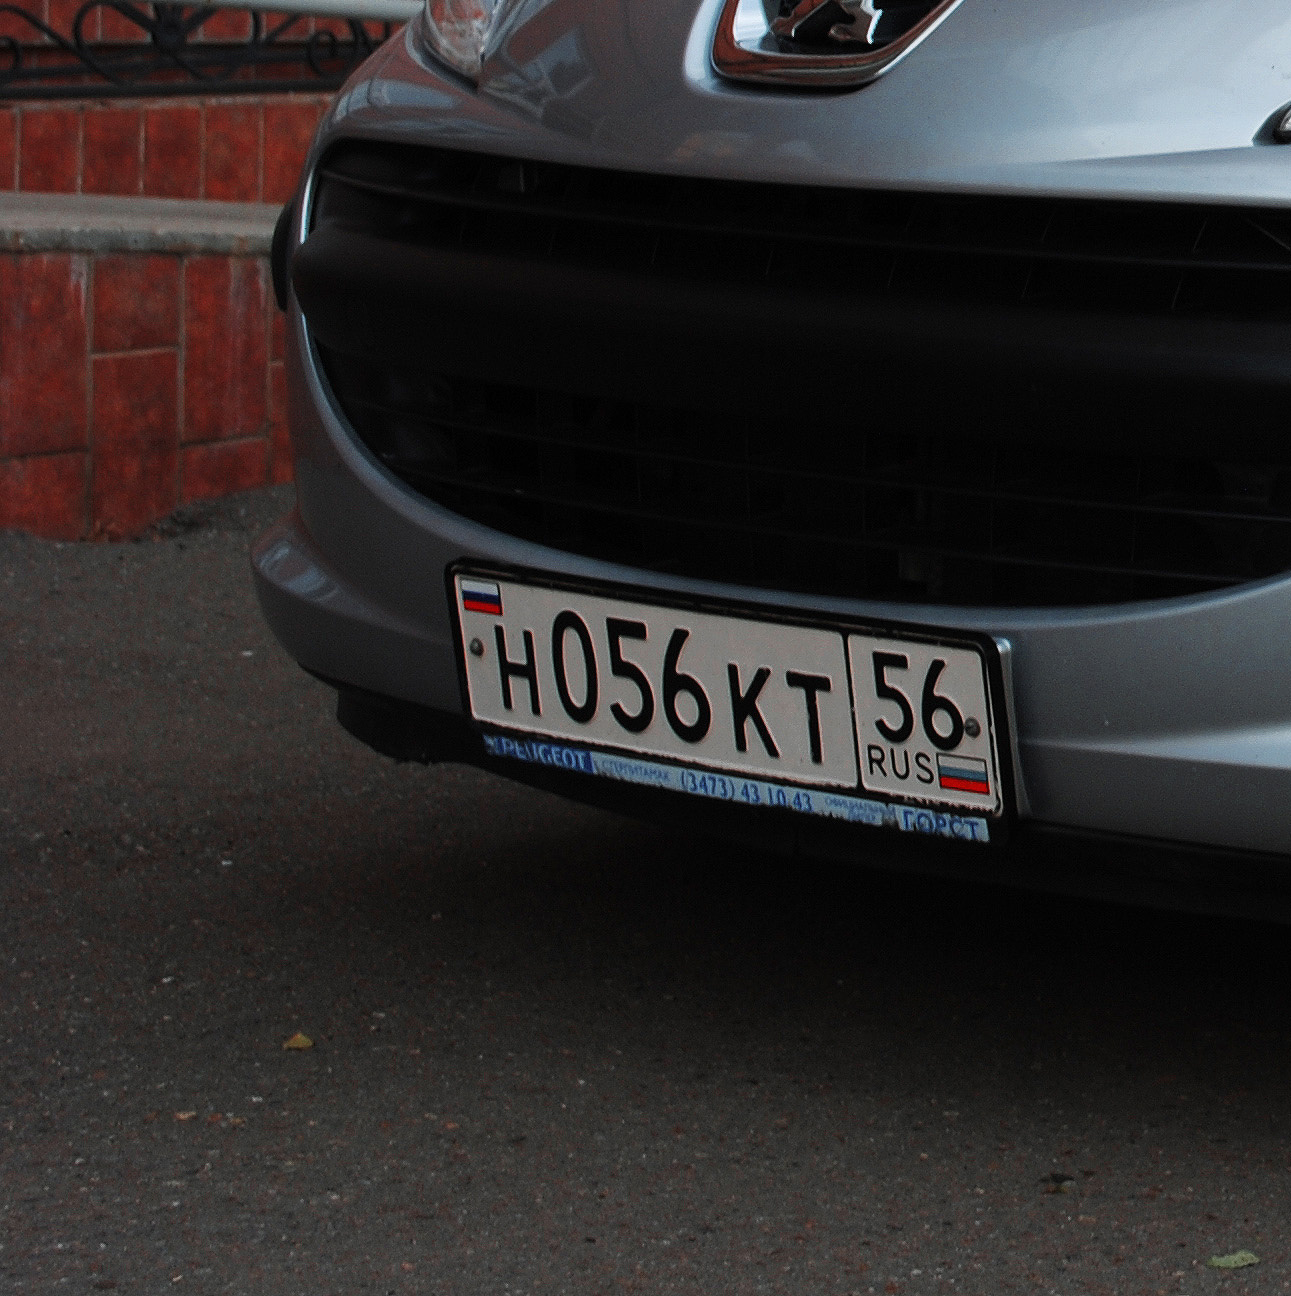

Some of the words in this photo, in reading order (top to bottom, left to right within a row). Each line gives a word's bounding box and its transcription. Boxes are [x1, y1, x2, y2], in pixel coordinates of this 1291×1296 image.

[871, 651, 965, 751] 56
[866, 744, 935, 785] RUS
[681, 769, 735, 799] (3473)
[741, 781, 761, 803] 43
